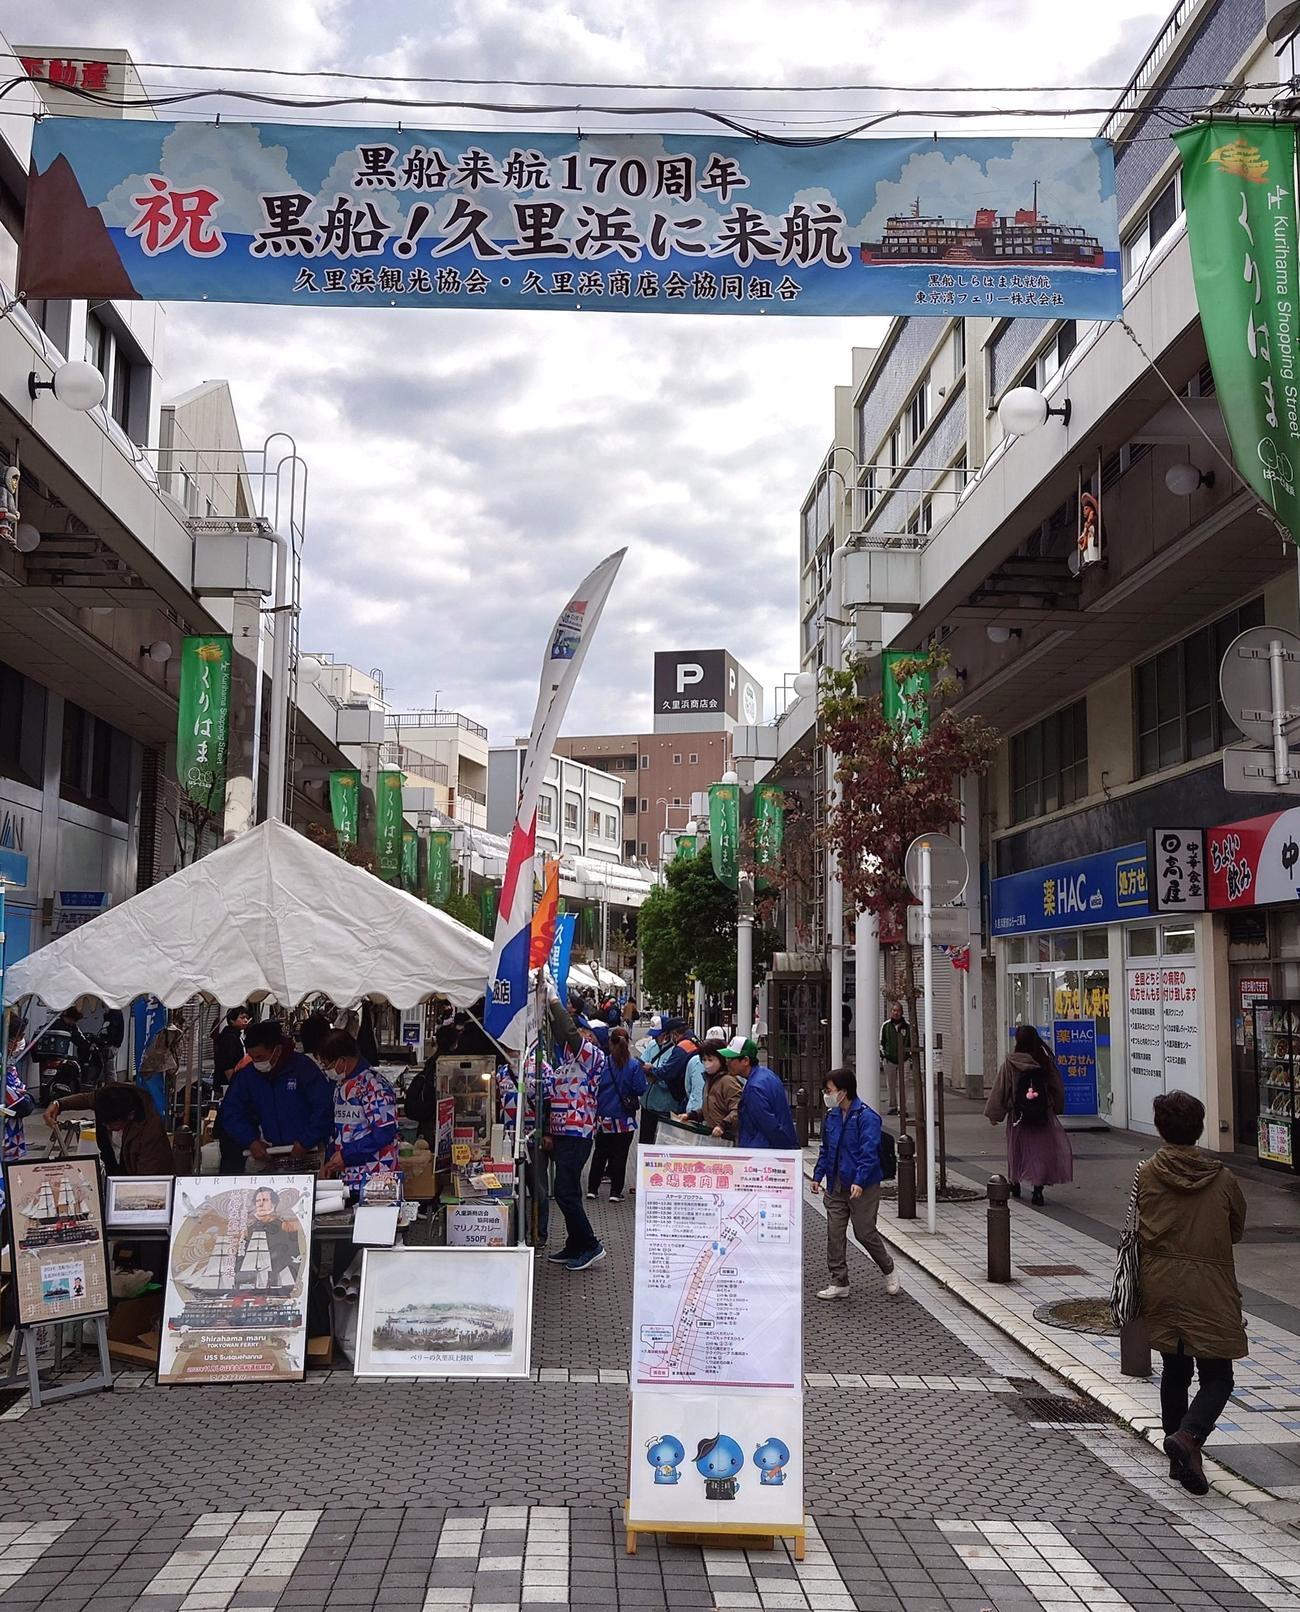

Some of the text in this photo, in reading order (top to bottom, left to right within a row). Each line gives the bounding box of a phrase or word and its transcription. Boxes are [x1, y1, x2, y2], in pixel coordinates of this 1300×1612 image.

[354, 145, 747, 205] 黒船来航170周年
[131, 176, 225, 255] 祝
[294, 268, 802, 301] 久里浜観光協会・久里浜商店会協同組合
[928, 274, 1051, 289] 黒船しらはま丸就航
[915, 291, 1064, 306] 東京湾フェリー株式会社
[1238, 192, 1279, 430] くりはま
[1273, 216, 1300, 440] Kurihama Shopping Street
[677, 663, 704, 693] P
[729, 667, 736, 697] P
[194, 666, 213, 763] くりはま
[662, 698, 719, 710] 久里浜商店会
[384, 791, 396, 855] くりはま
[720, 803, 729, 863] くりはま
[1211, 833, 1241, 873] ちょい
[1282, 834, 1299, 881] 中
[1161, 833, 1187, 905] 日高屋
[1186, 842, 1203, 896] 中華食堂
[1226, 858, 1252, 902] 飲み
[1043, 873, 1088, 916] 薬 HAC
[1134, 970, 1186, 986] 全国どちらの病院の
[1056, 1029, 1094, 1044] 薬 HAC
[1057, 1055, 1095, 1066] 処方せん
[1067, 1066, 1087, 1078] 受付
[336, 1110, 361, 1118] ISSAN
[176, 1176, 313, 1186] KURIHAMA
[649, 1173, 730, 1190] 会場案内図
[453, 1224, 502, 1232] マリノスカレー
[465, 1235, 487, 1243] 550円
[200, 1335, 243, 1343] Shirahama
